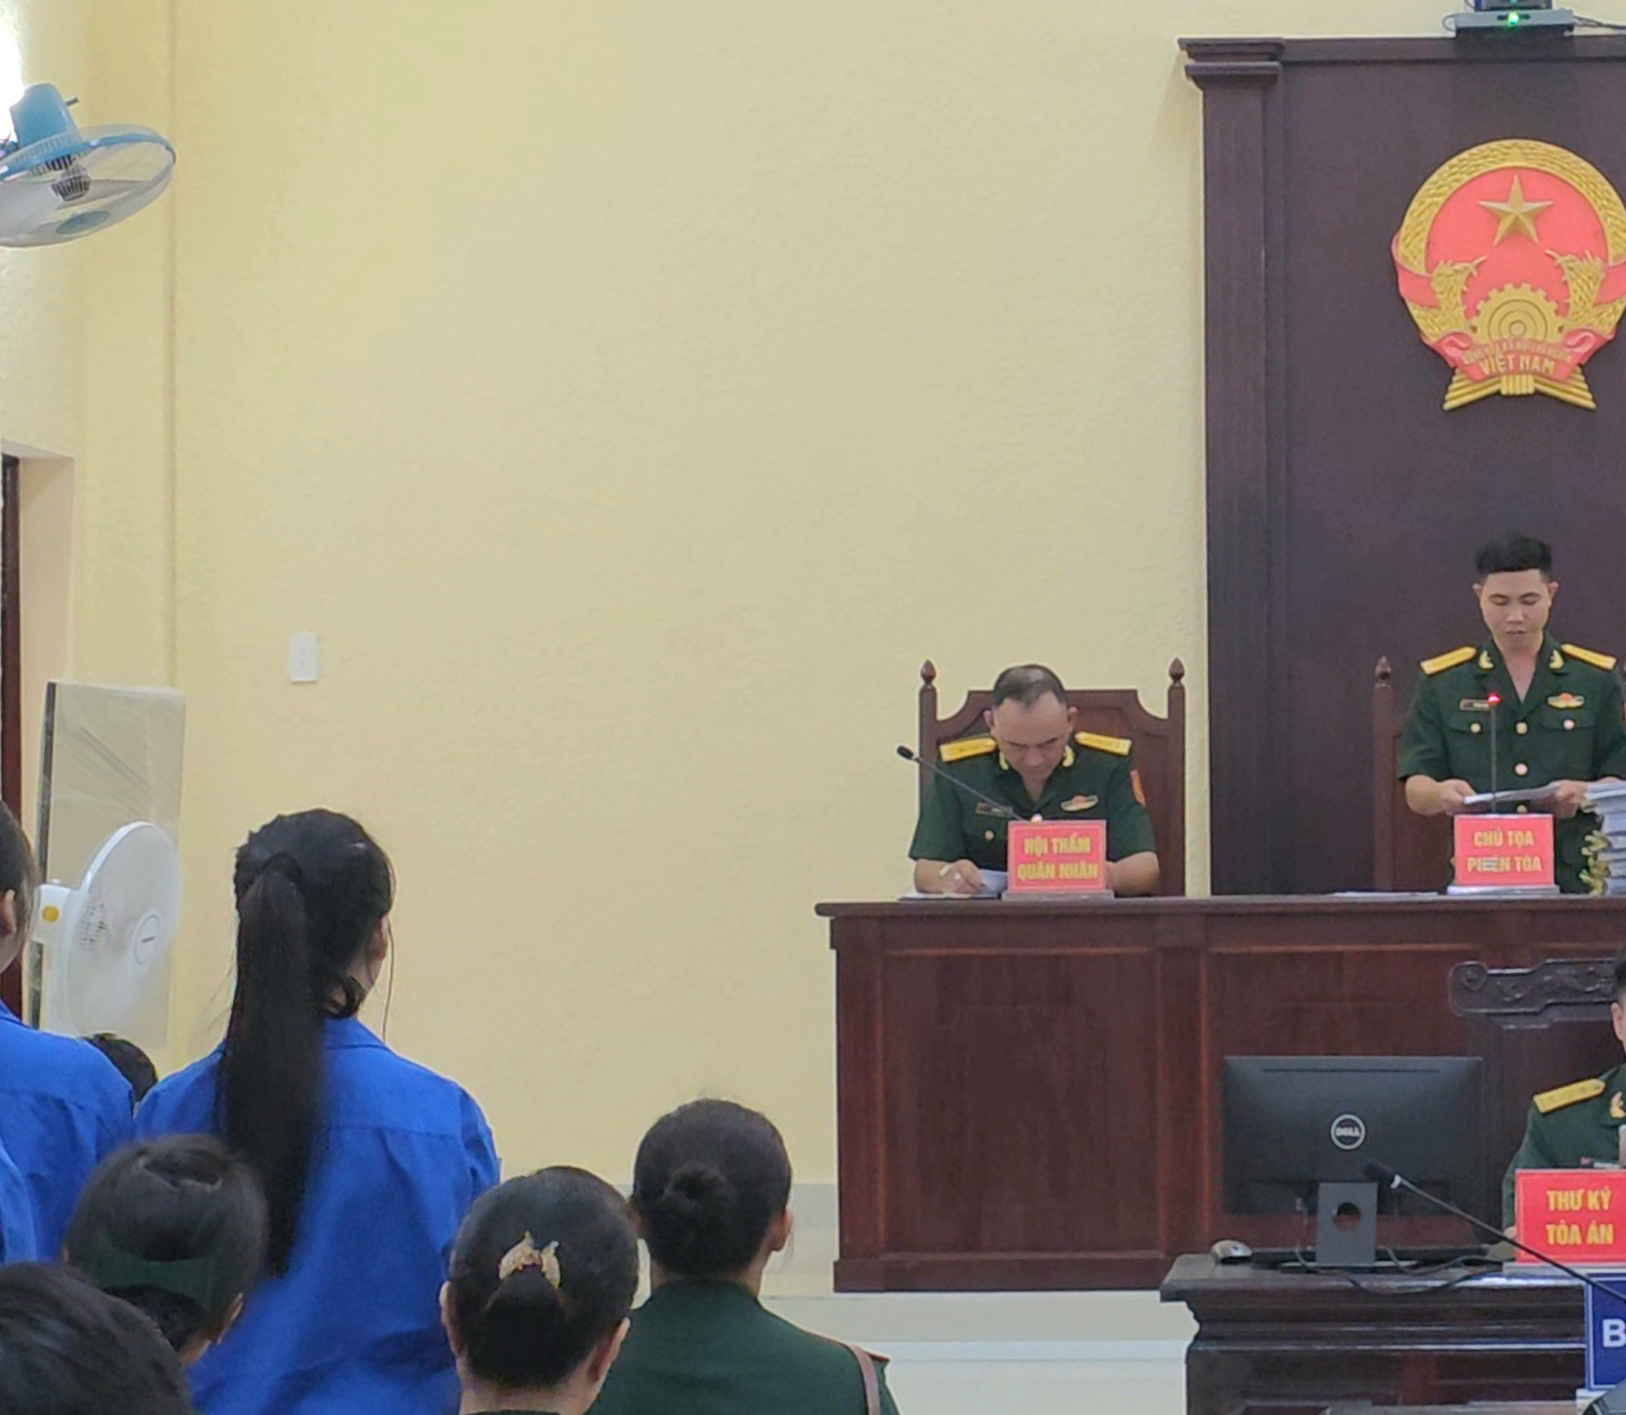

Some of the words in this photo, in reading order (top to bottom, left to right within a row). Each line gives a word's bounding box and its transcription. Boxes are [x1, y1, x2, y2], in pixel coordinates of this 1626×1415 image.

[1546, 1188, 1585, 1211] THƯ
[1587, 1185, 1612, 1211] KÝ
[1586, 1219, 1614, 1245] ÁN
